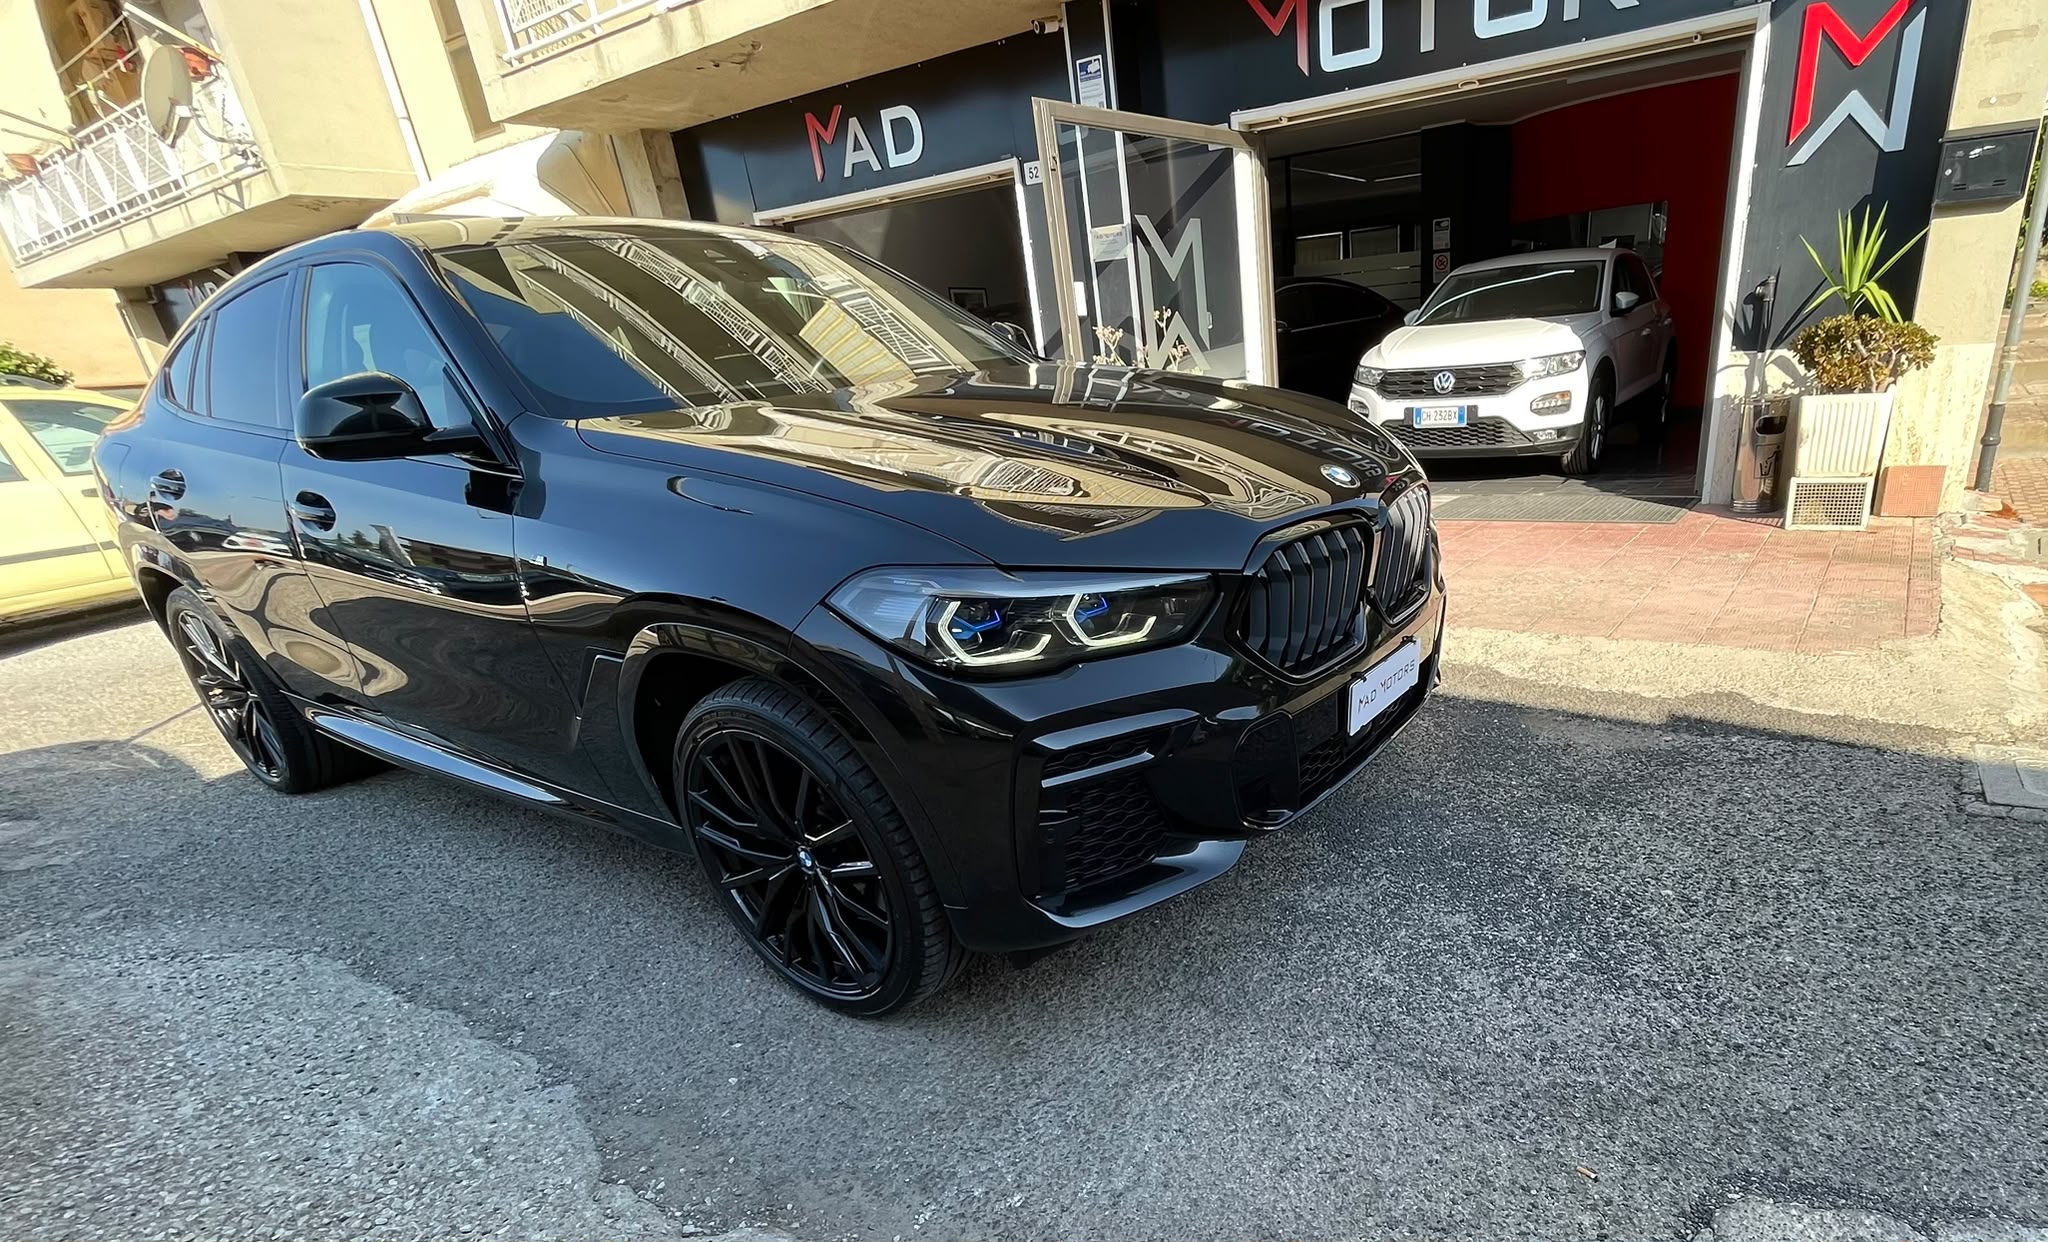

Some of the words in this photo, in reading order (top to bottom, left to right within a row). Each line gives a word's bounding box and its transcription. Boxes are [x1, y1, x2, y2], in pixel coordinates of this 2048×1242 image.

[804, 104, 924, 183] MAD
[1028, 166, 1040, 180] 52
[1358, 689, 1376, 713] MAD
[1380, 659, 1415, 692] MOTORS
